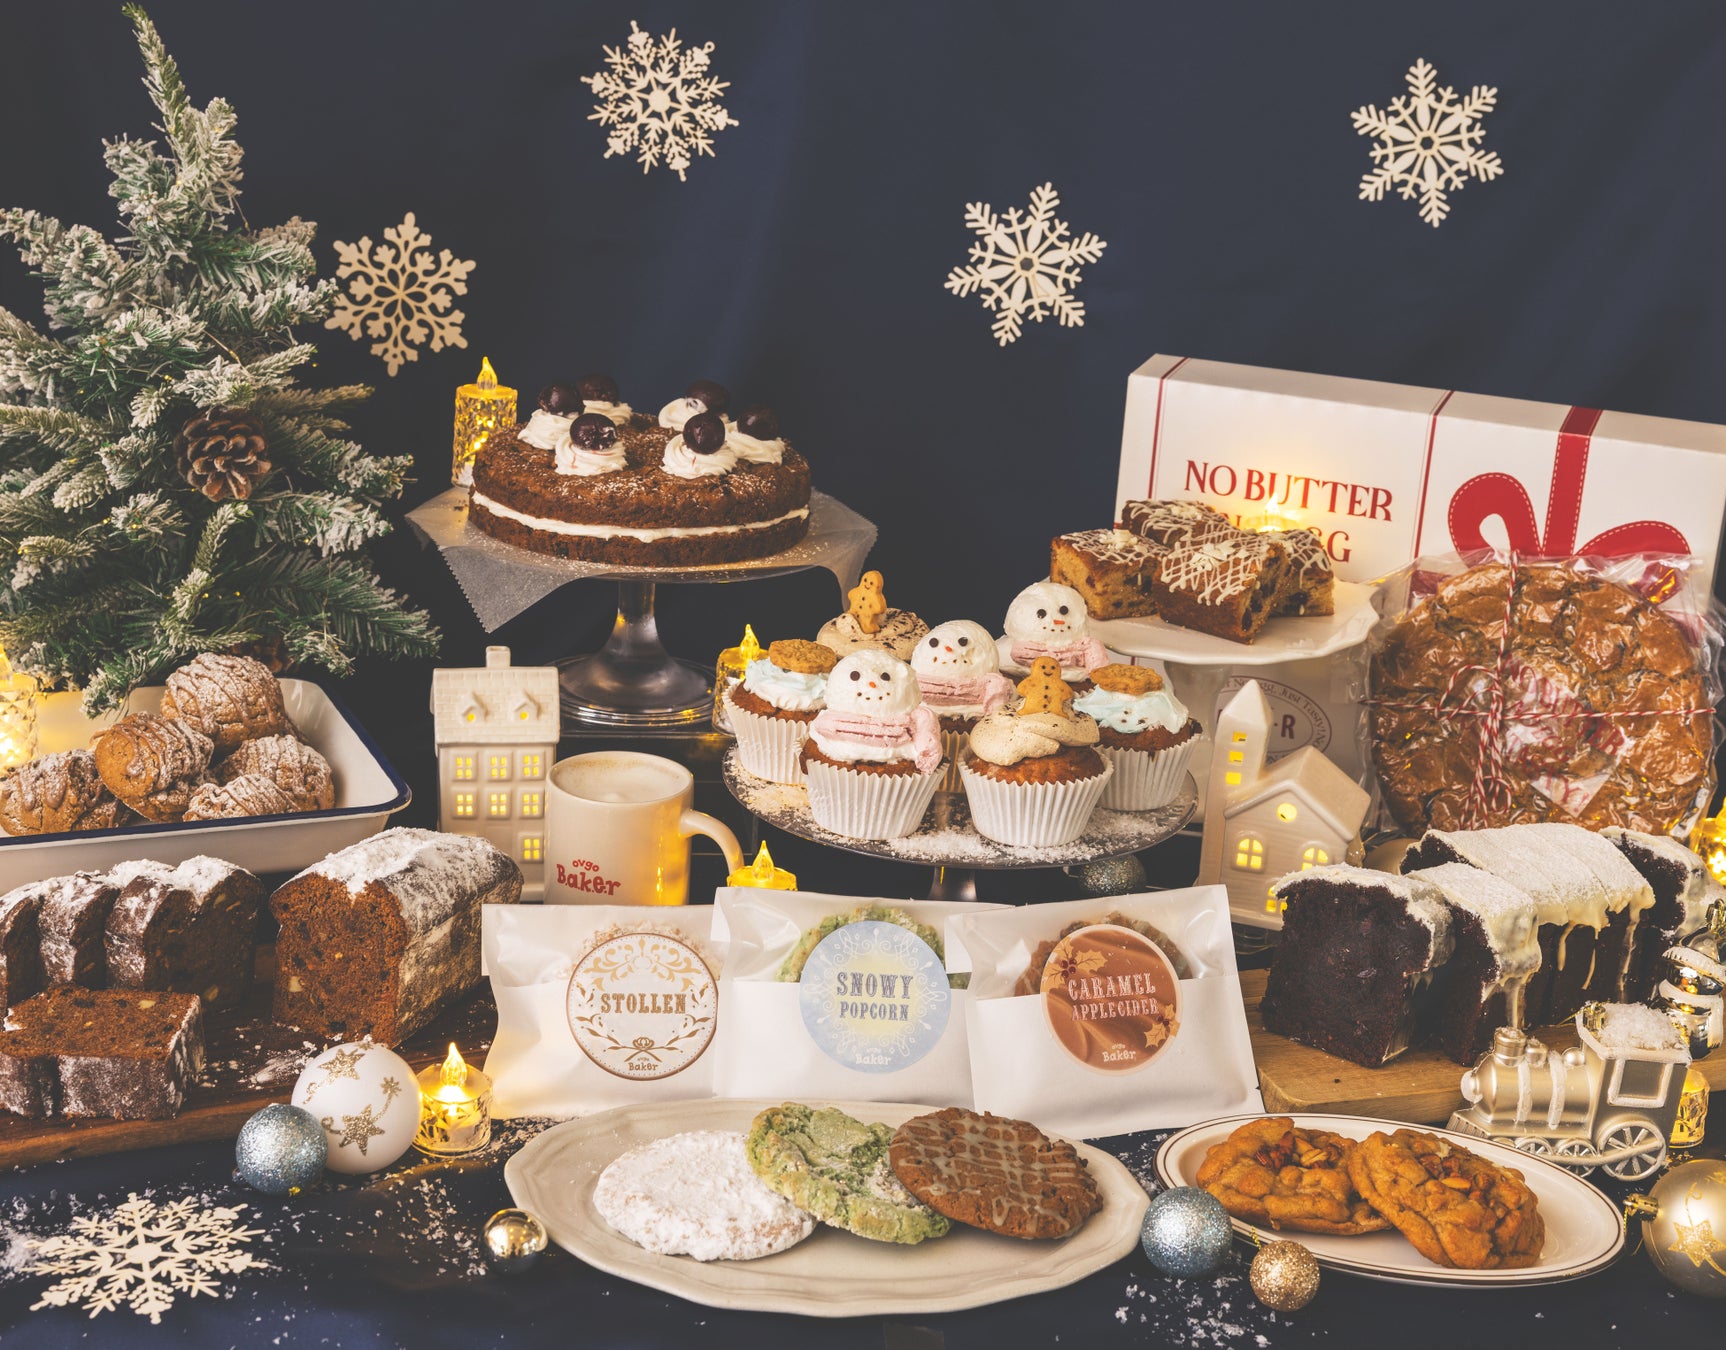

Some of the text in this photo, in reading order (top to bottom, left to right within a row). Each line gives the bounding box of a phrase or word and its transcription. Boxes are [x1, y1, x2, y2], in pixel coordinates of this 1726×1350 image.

[1184, 459, 1393, 522] NO BUTTER
[572, 859, 599, 872] ovgo
[836, 971, 914, 999] SNOWY
[1068, 972, 1156, 1001] CARAMEL
[600, 992, 687, 1014] STOLLEN
[839, 1001, 909, 1021] POPCORN
